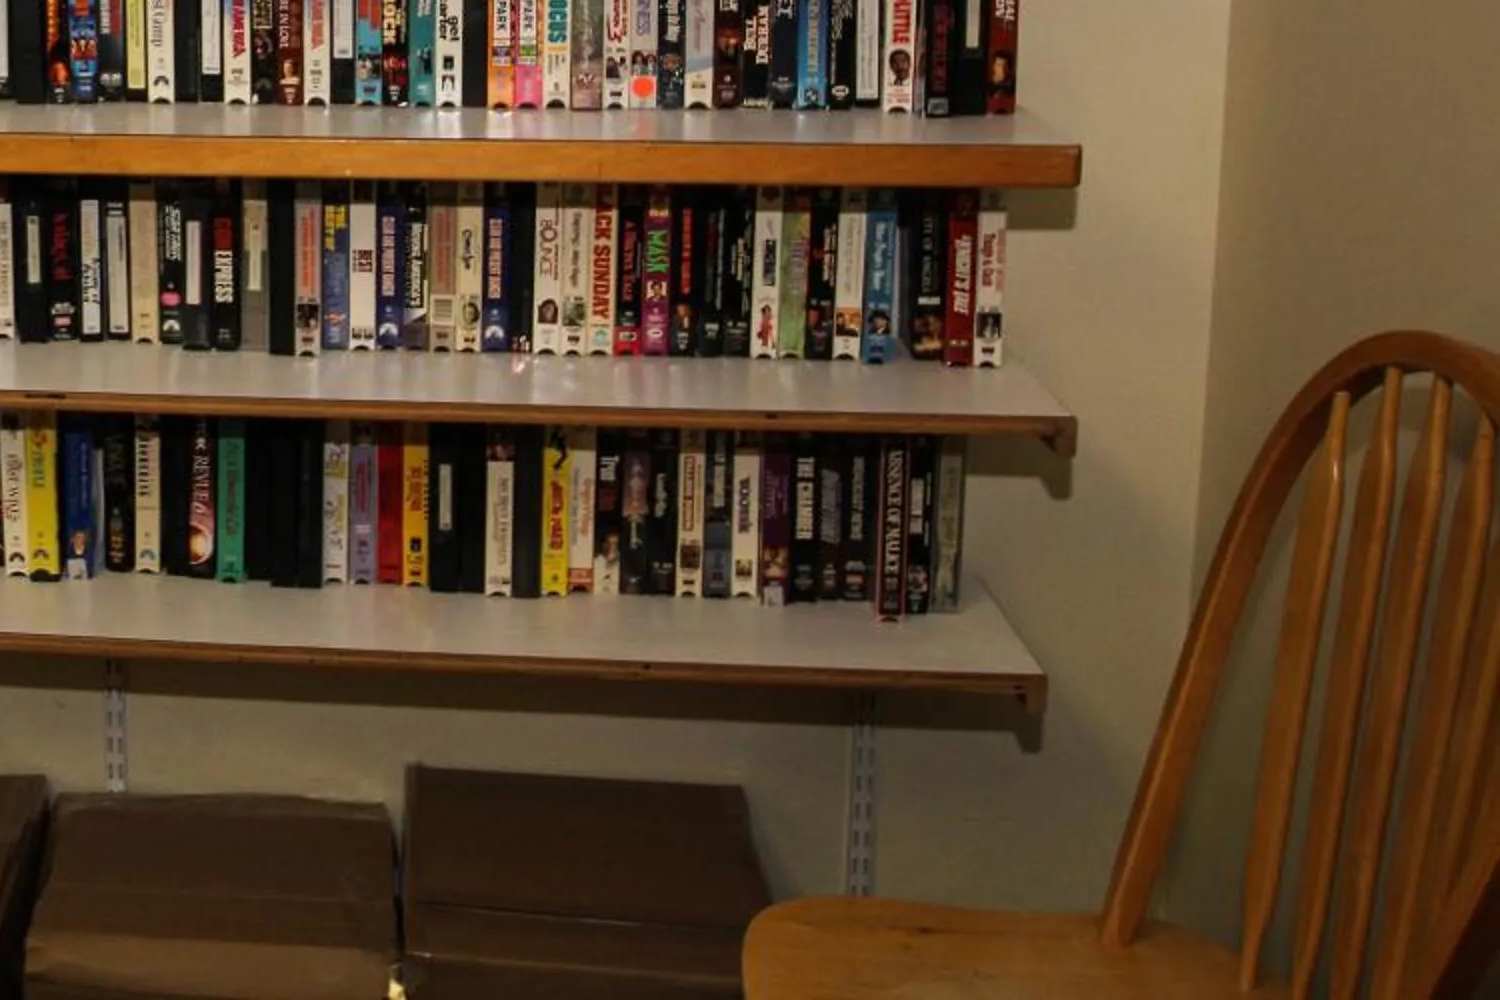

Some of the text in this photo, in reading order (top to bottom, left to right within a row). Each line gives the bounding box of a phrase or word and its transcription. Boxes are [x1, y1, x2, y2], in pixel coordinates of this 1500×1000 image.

[150, 7, 167, 48] Gump
[280, 13, 290, 23] IN
[448, 16, 460, 42] get
[496, 0, 506, 32] PARK
[523, 0, 534, 31] PARK
[744, 16, 756, 50] BULL
[756, 5, 769, 64] DURHAM
[279, 25, 290, 49] LOVE
[648, 229, 669, 273] MASK
[214, 251, 234, 303] EXPRESS
[593, 244, 612, 319] SUNDAY
[795, 457, 815, 540] THE CHAMBER
[884, 449, 904, 574] ABSENCE OF MALICE
